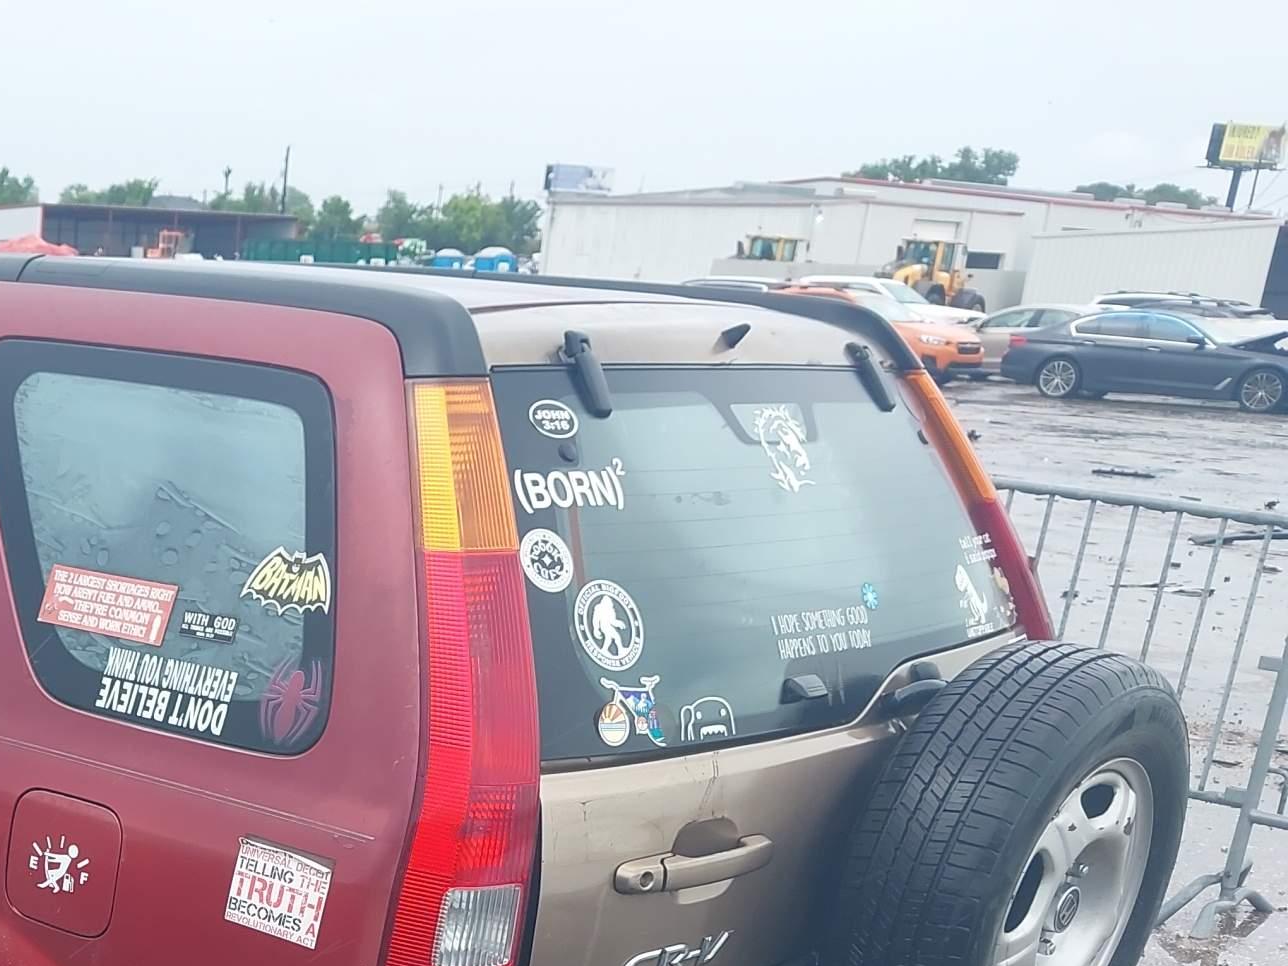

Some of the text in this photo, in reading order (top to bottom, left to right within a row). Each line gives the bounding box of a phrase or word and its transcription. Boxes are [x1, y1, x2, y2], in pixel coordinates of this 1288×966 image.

[534, 410, 570, 420] JOHN
[542, 420, 570, 430] 3:16
[54, 570, 68, 582] THE
[73, 573, 104, 587] LARGEST
[105, 578, 150, 596] SHORTAGES
[150, 587, 174, 602] RIGHT
[54, 582, 71, 596] NOW
[96, 590, 116, 604] FUEL
[116, 594, 133, 608] AND
[250, 556, 326, 604] BATMAN
[108, 605, 151, 624] COMMON
[578, 583, 634, 615] OFFICIAL BIGFOOT
[58, 610, 84, 624] SENSE
[83, 614, 98, 627] AND
[98, 618, 122, 632] WORK
[184, 612, 210, 626] WITH
[214, 616, 236, 630] GOD
[771, 605, 868, 636] I HOPE SOMETHING GOOD
[778, 628, 872, 660] HAPPENS TO YOU TODAY
[104, 646, 238, 702] EVERYTHING YOU THINK
[96, 677, 228, 736] DON'T BELIEVE
[29, 856, 39, 870] E
[241, 845, 293, 869] UNIVERSAL
[80, 872, 89, 884] F
[239, 856, 328, 894] TELLING THE
[235, 870, 324, 922] TRUTH
[226, 912, 314, 948] REVOLUTIONARY ACT
[228, 896, 316, 938] BECOMES A
